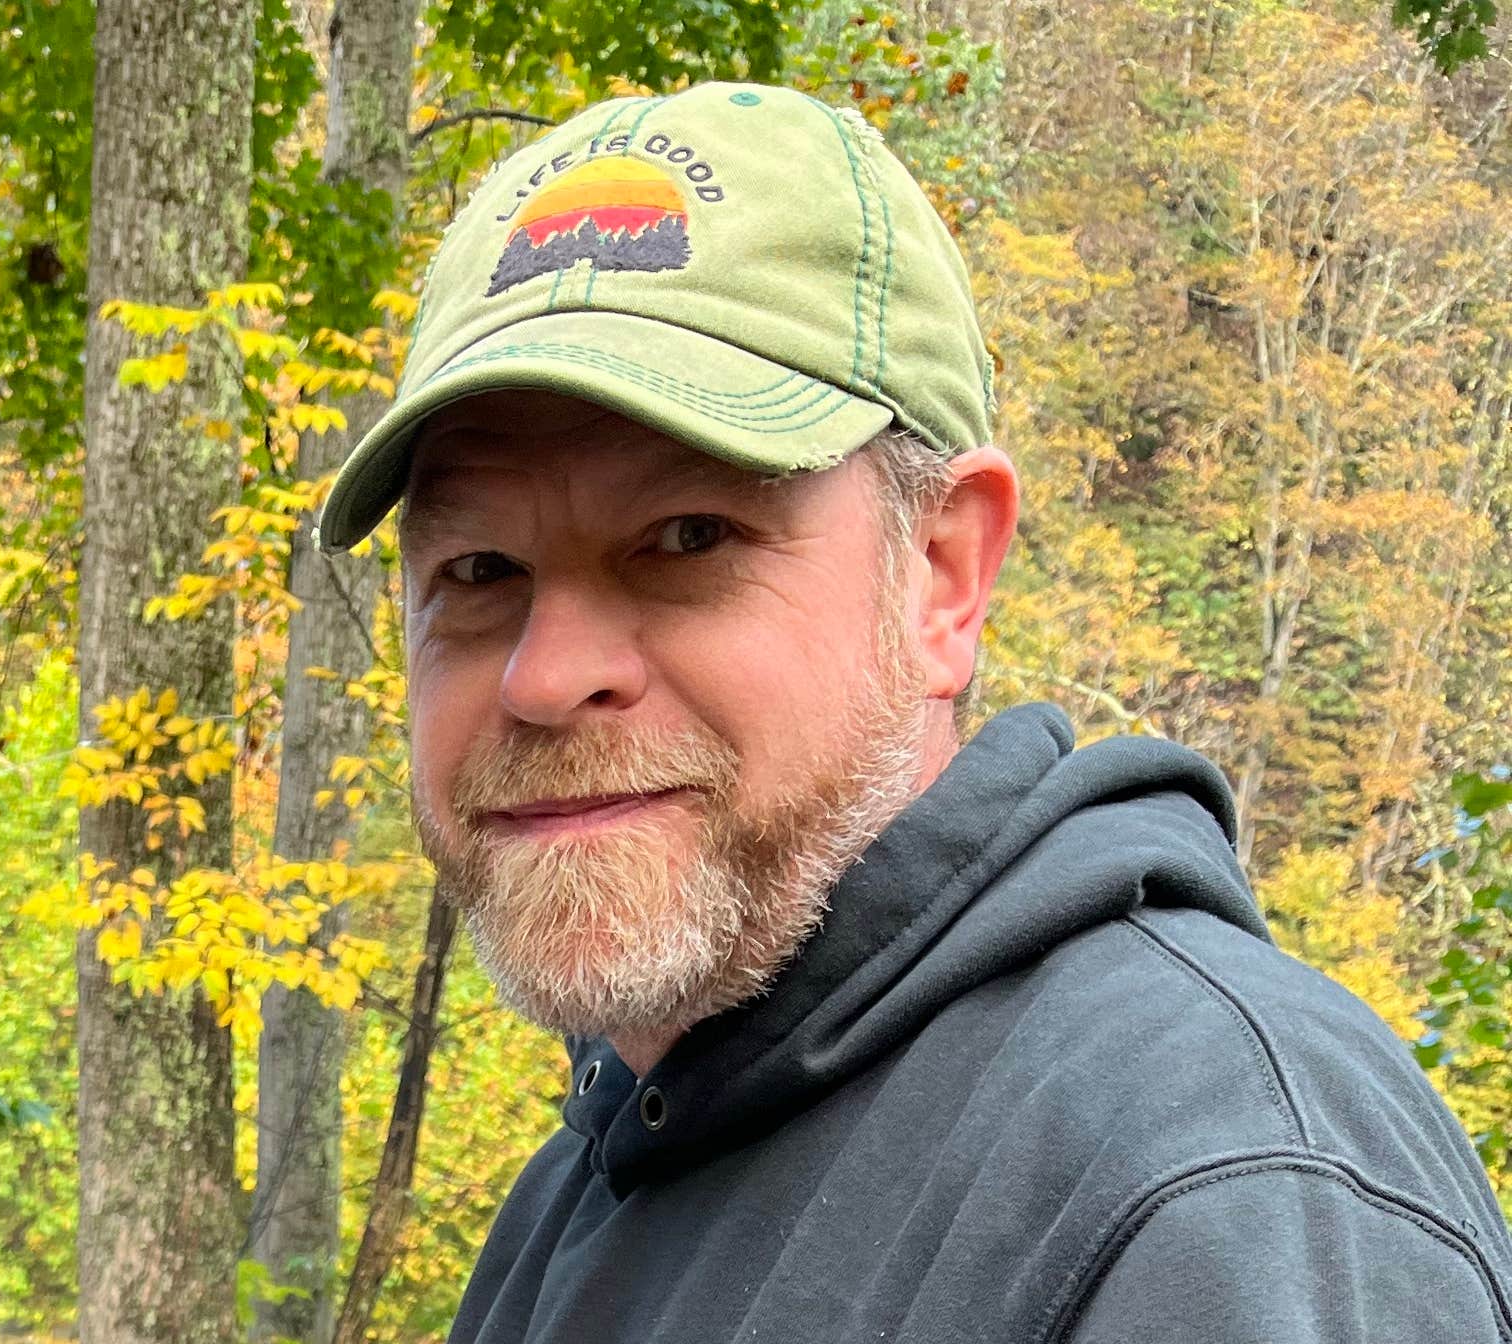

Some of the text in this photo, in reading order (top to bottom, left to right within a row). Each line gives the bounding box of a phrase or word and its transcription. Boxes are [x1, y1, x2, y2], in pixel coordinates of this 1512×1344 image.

[496, 134, 724, 221] LIFE IS GOOD
